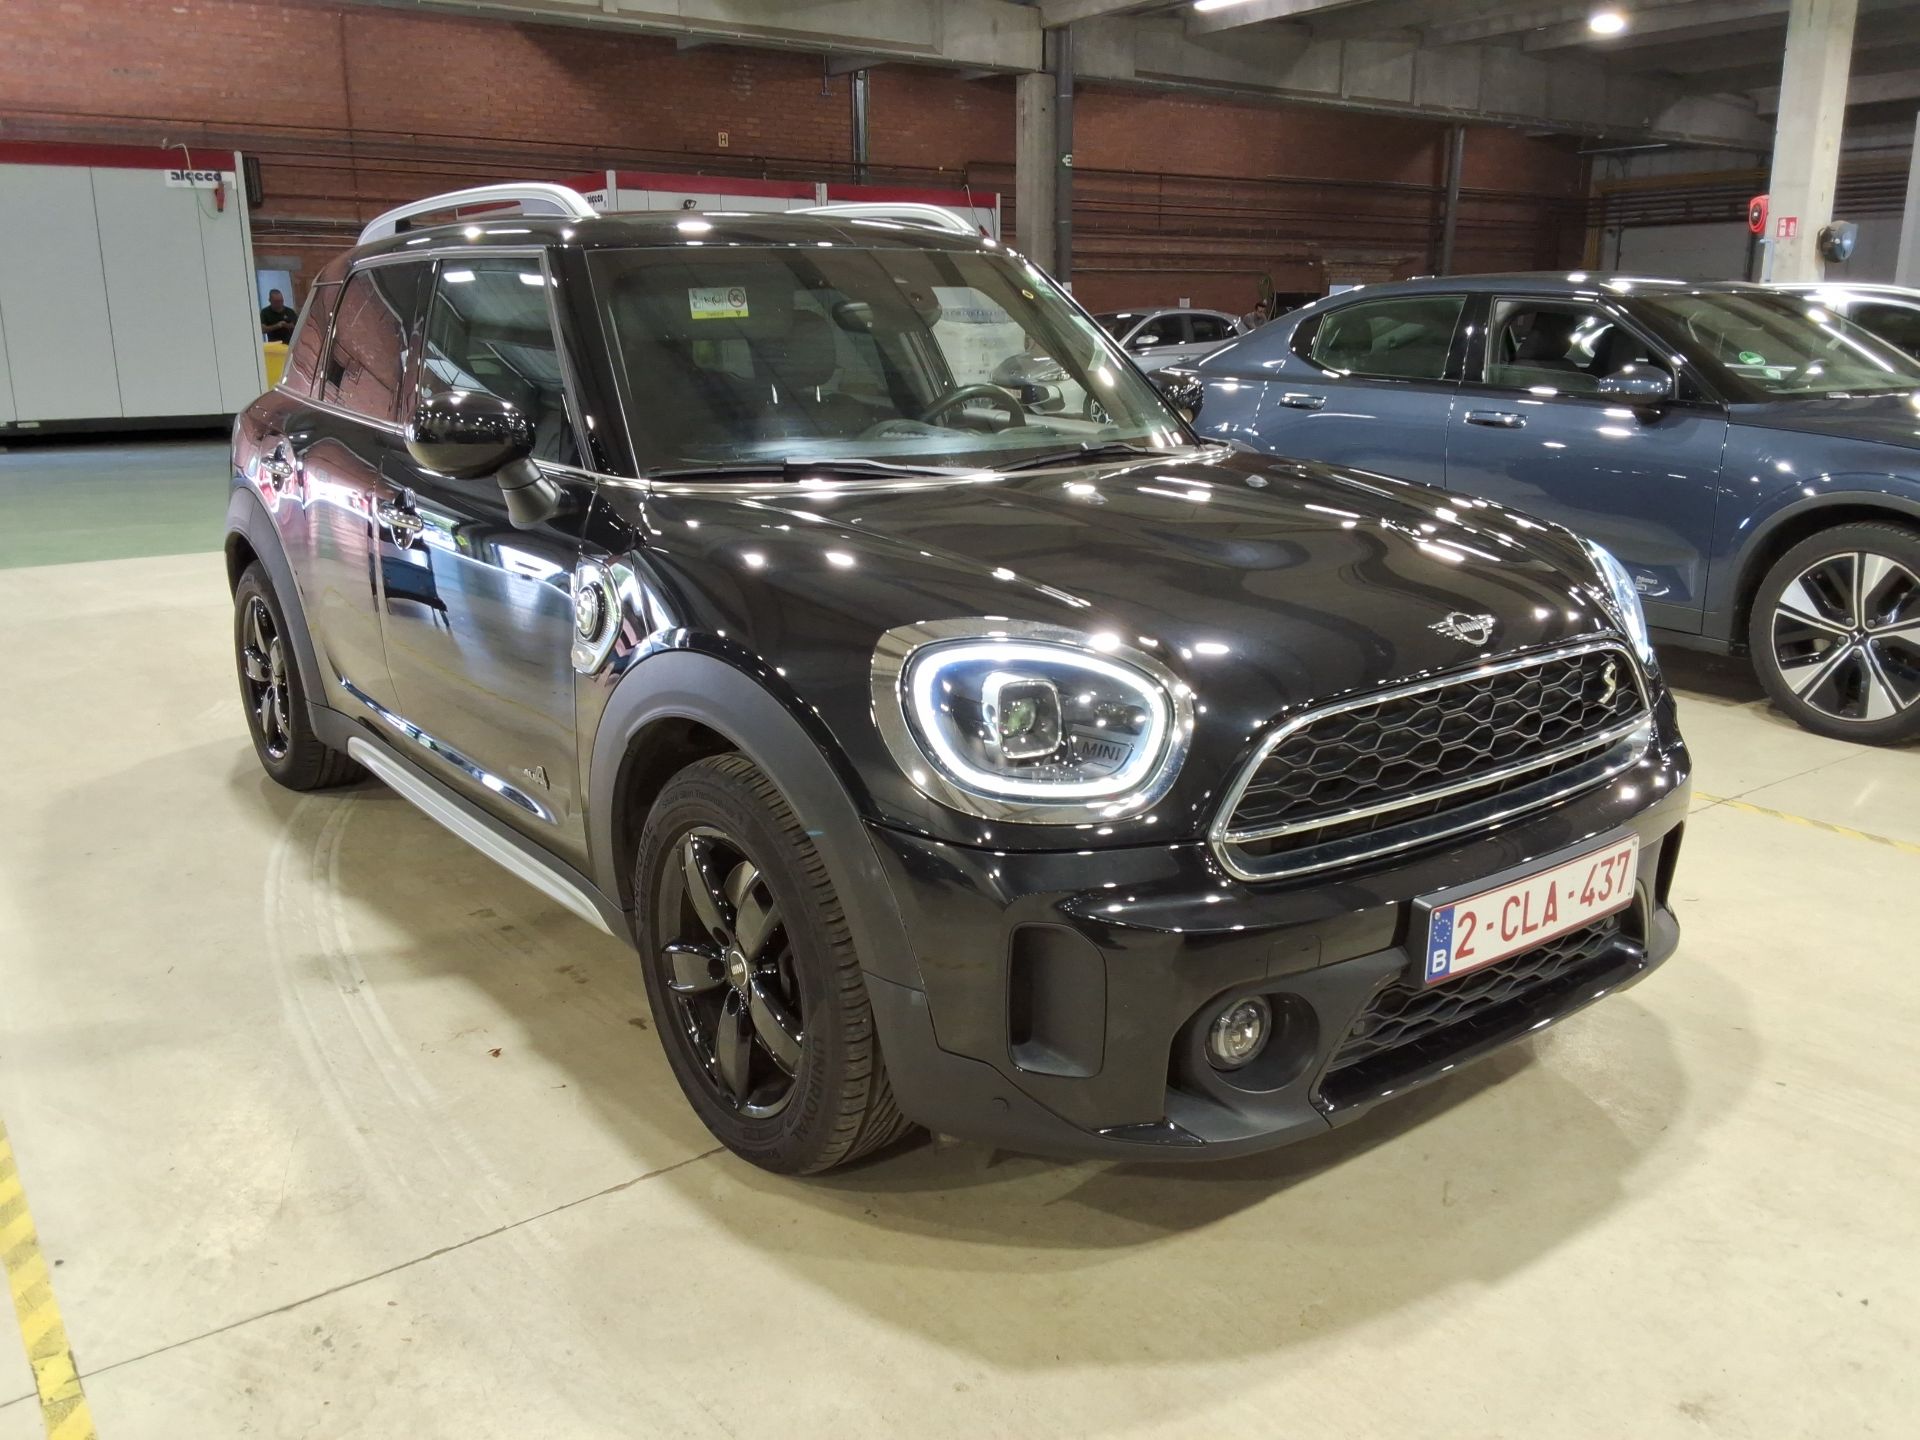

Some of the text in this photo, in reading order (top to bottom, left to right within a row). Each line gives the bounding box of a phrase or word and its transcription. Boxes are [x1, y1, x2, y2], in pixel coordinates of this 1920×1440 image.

[1082, 741, 1121, 761] MINI
[1455, 849, 1632, 961] 2-CLA-437
[1432, 949, 1447, 973] B
[790, 1036, 824, 1142] UNIROYAL
